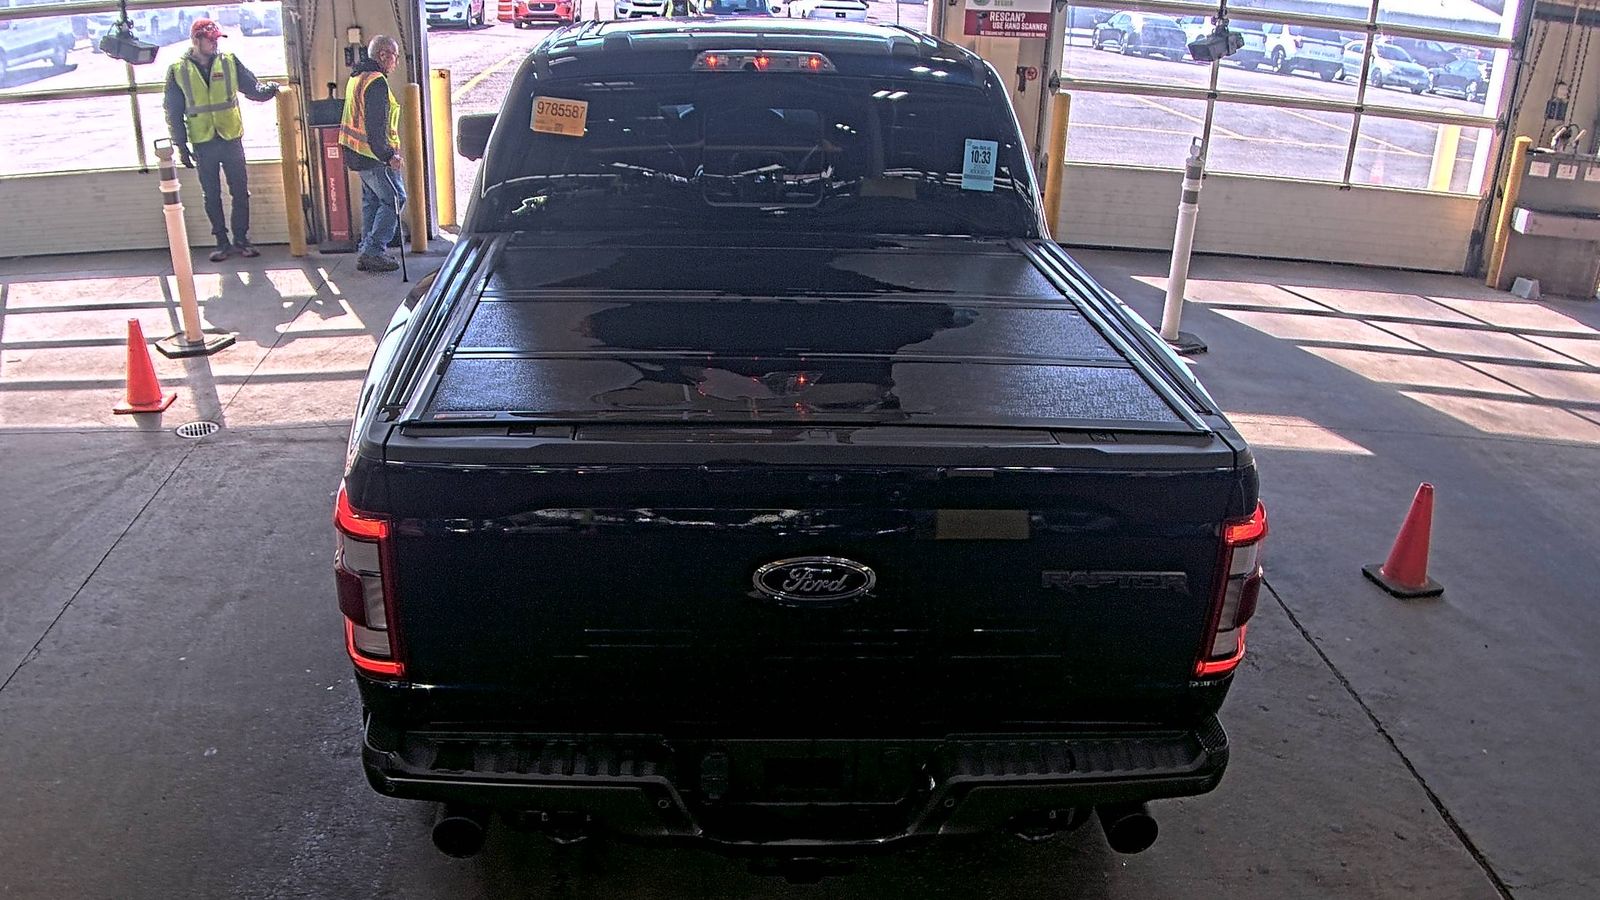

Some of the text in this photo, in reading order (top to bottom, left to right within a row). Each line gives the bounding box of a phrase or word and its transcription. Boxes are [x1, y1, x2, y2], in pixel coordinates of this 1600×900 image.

[989, 11, 1026, 22] RESCAN?
[992, 21, 1048, 31] USE HAND SCANNER
[536, 101, 586, 119] 9785587
[970, 150, 992, 165] 10:33
[782, 566, 848, 592] Ford
